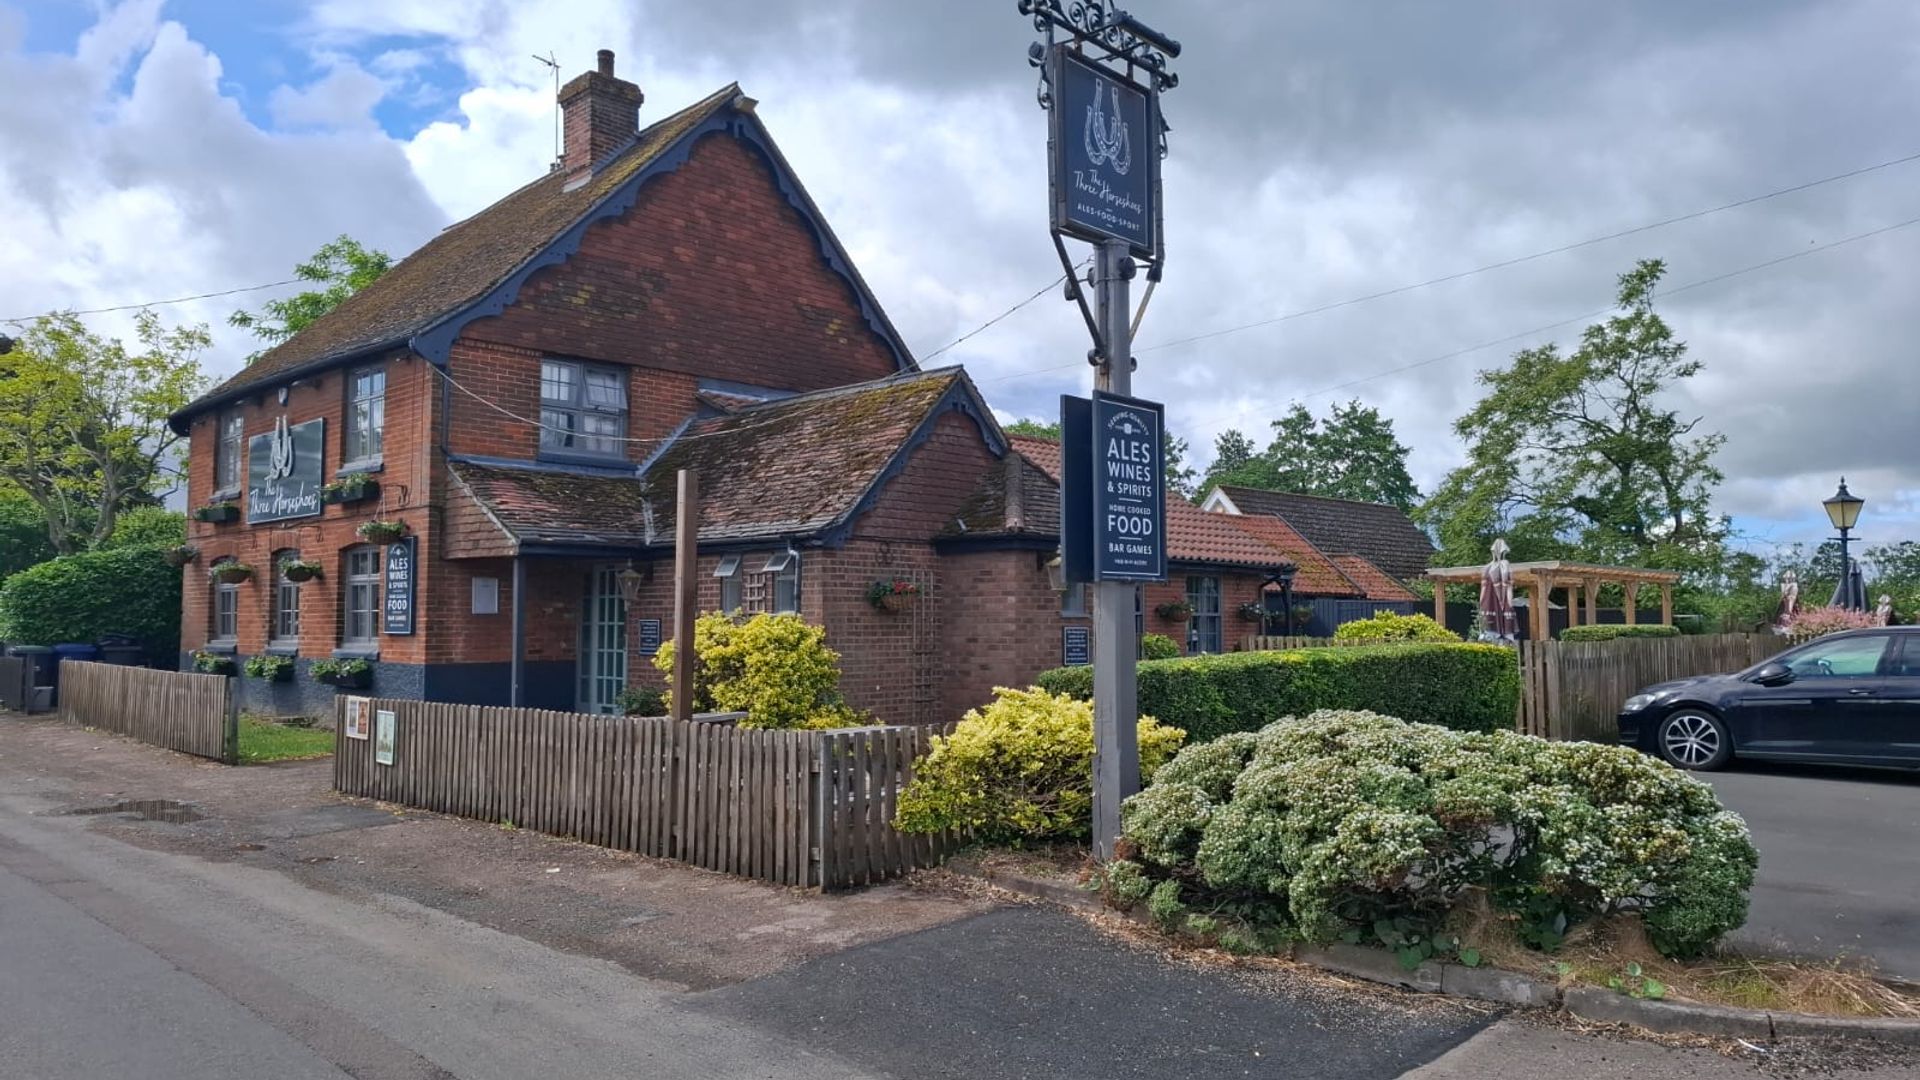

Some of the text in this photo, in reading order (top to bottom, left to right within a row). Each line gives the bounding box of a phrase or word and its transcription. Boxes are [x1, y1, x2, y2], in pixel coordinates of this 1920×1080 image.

[1088, 169, 1102, 186] The
[1073, 170, 1142, 214] Three Horseshoes
[1107, 437, 1150, 463] ALES
[1107, 460, 1151, 482] WINES
[264, 476, 276, 497] The
[1107, 481, 1152, 497] & SPIRITS
[250, 481, 317, 516] Three Horseshoes
[1108, 504, 1151, 515] HOME COOKED
[1108, 514, 1152, 535] FOOD
[1108, 542, 1152, 555] BAR GAMES
[389, 557, 408, 570] ALES
[389, 570, 408, 580] WINES
[388, 599, 407, 610] FOOD
